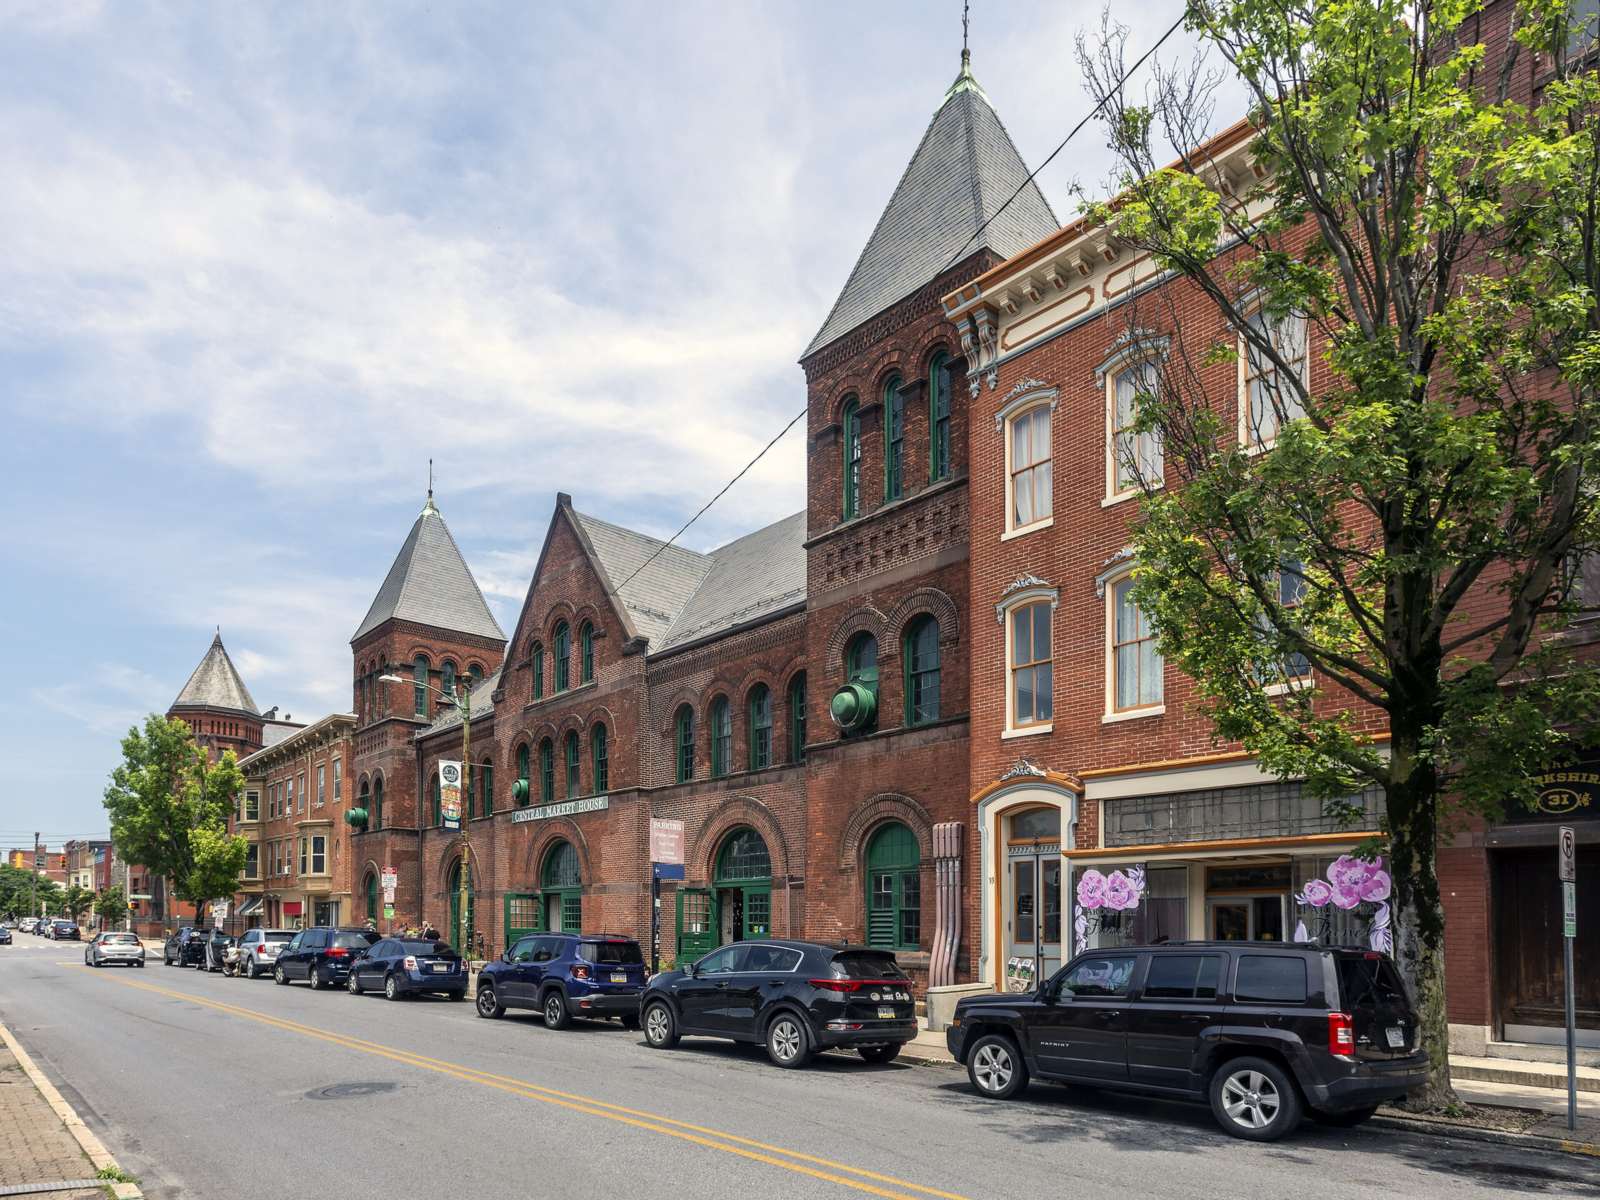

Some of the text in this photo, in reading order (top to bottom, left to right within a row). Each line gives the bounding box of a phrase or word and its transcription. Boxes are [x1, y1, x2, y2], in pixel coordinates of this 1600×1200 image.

[1548, 794, 1569, 805] 31
[514, 798, 604, 822] CENTRAL MARKET HOUSE
